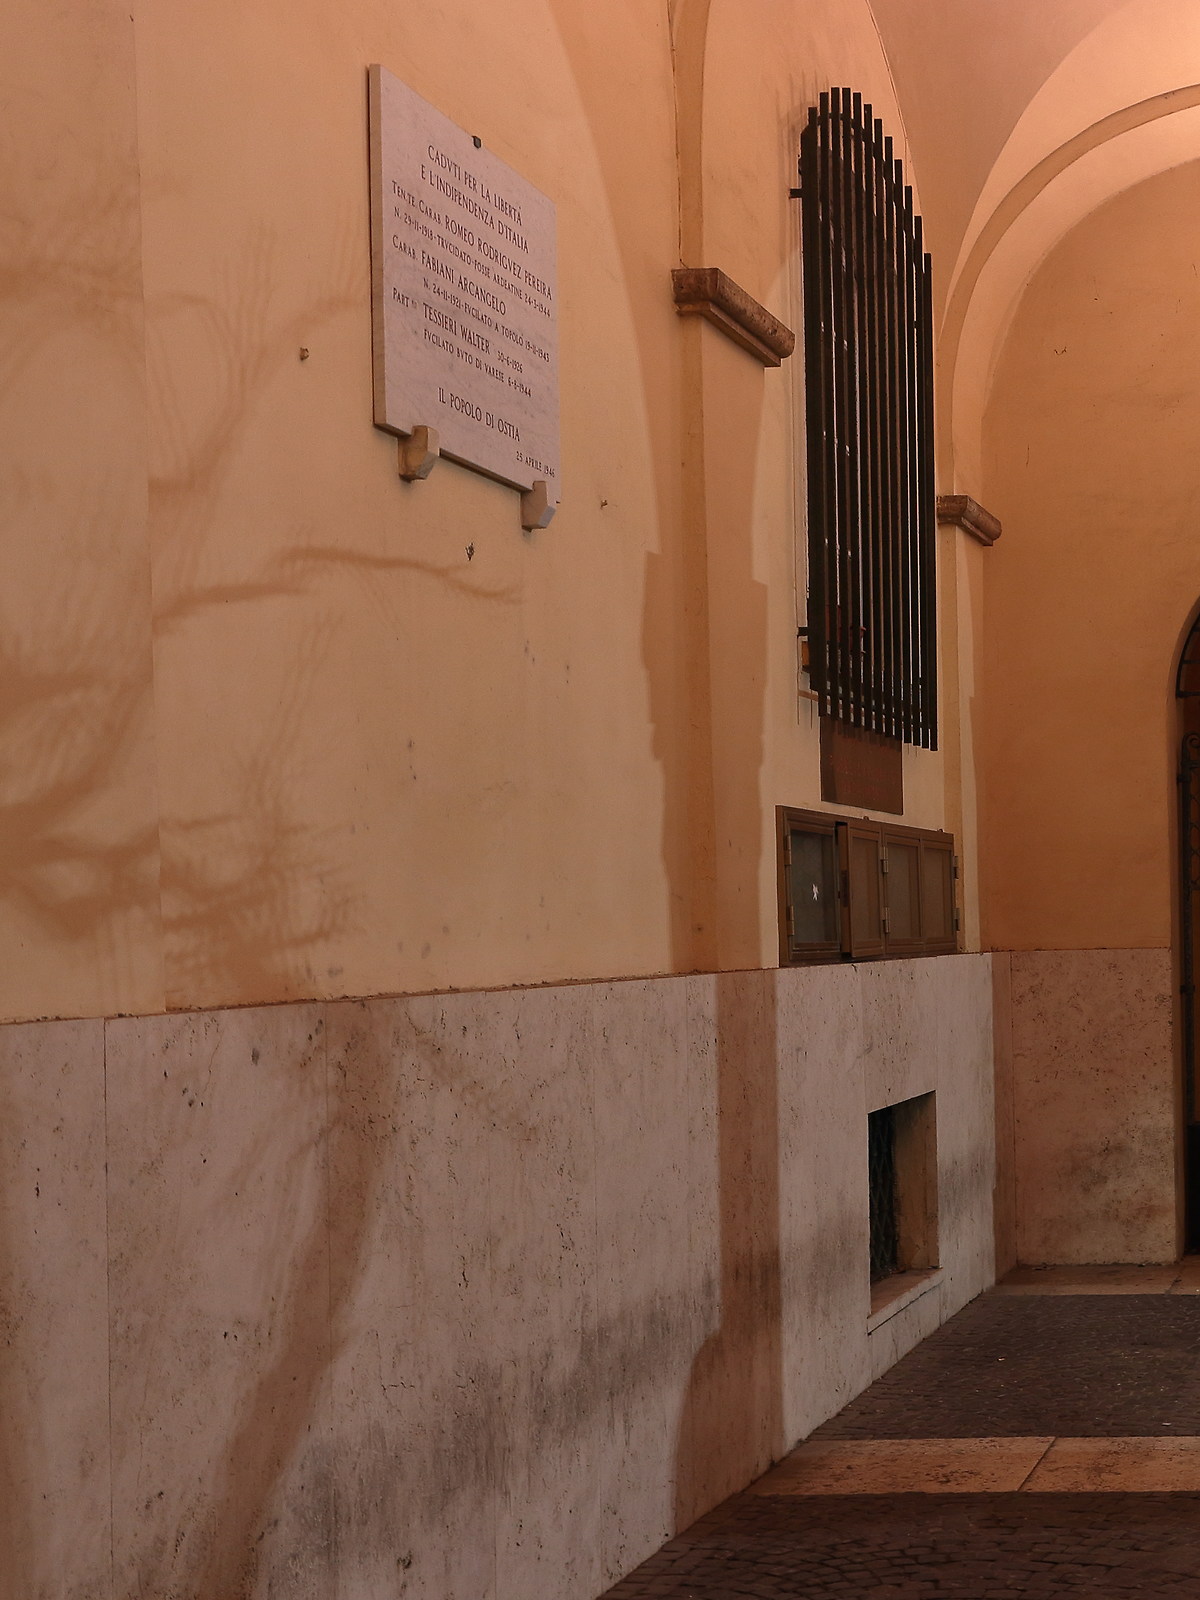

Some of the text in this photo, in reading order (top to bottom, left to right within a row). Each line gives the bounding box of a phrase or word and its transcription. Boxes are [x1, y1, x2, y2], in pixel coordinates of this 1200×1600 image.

[428, 144, 460, 181] CADVTI
[464, 171, 477, 193] PER
[481, 184, 490, 203] LA
[421, 164, 528, 253] E L'INDIPENDENZA D'ITALIA
[421, 250, 454, 284] FABIANI
[459, 274, 506, 317] ARCANGELO
[445, 215, 474, 248] ROMEO
[478, 238, 521, 280] RODRIGVEZ
[525, 270, 552, 300] PEREIRA
[493, 272, 522, 299] ARDEATINE
[423, 303, 457, 335] TESSIERI
[461, 325, 490, 354] WALTER
[495, 322, 499, 332] A
[424, 329, 454, 354] FVCILATO
[476, 358, 482, 370] DI
[485, 363, 504, 382] VARESE
[439, 388, 520, 441] IL POPOLO DI OSTIA
[517, 451, 523, 463] 25
[525, 455, 542, 471] APRILE
